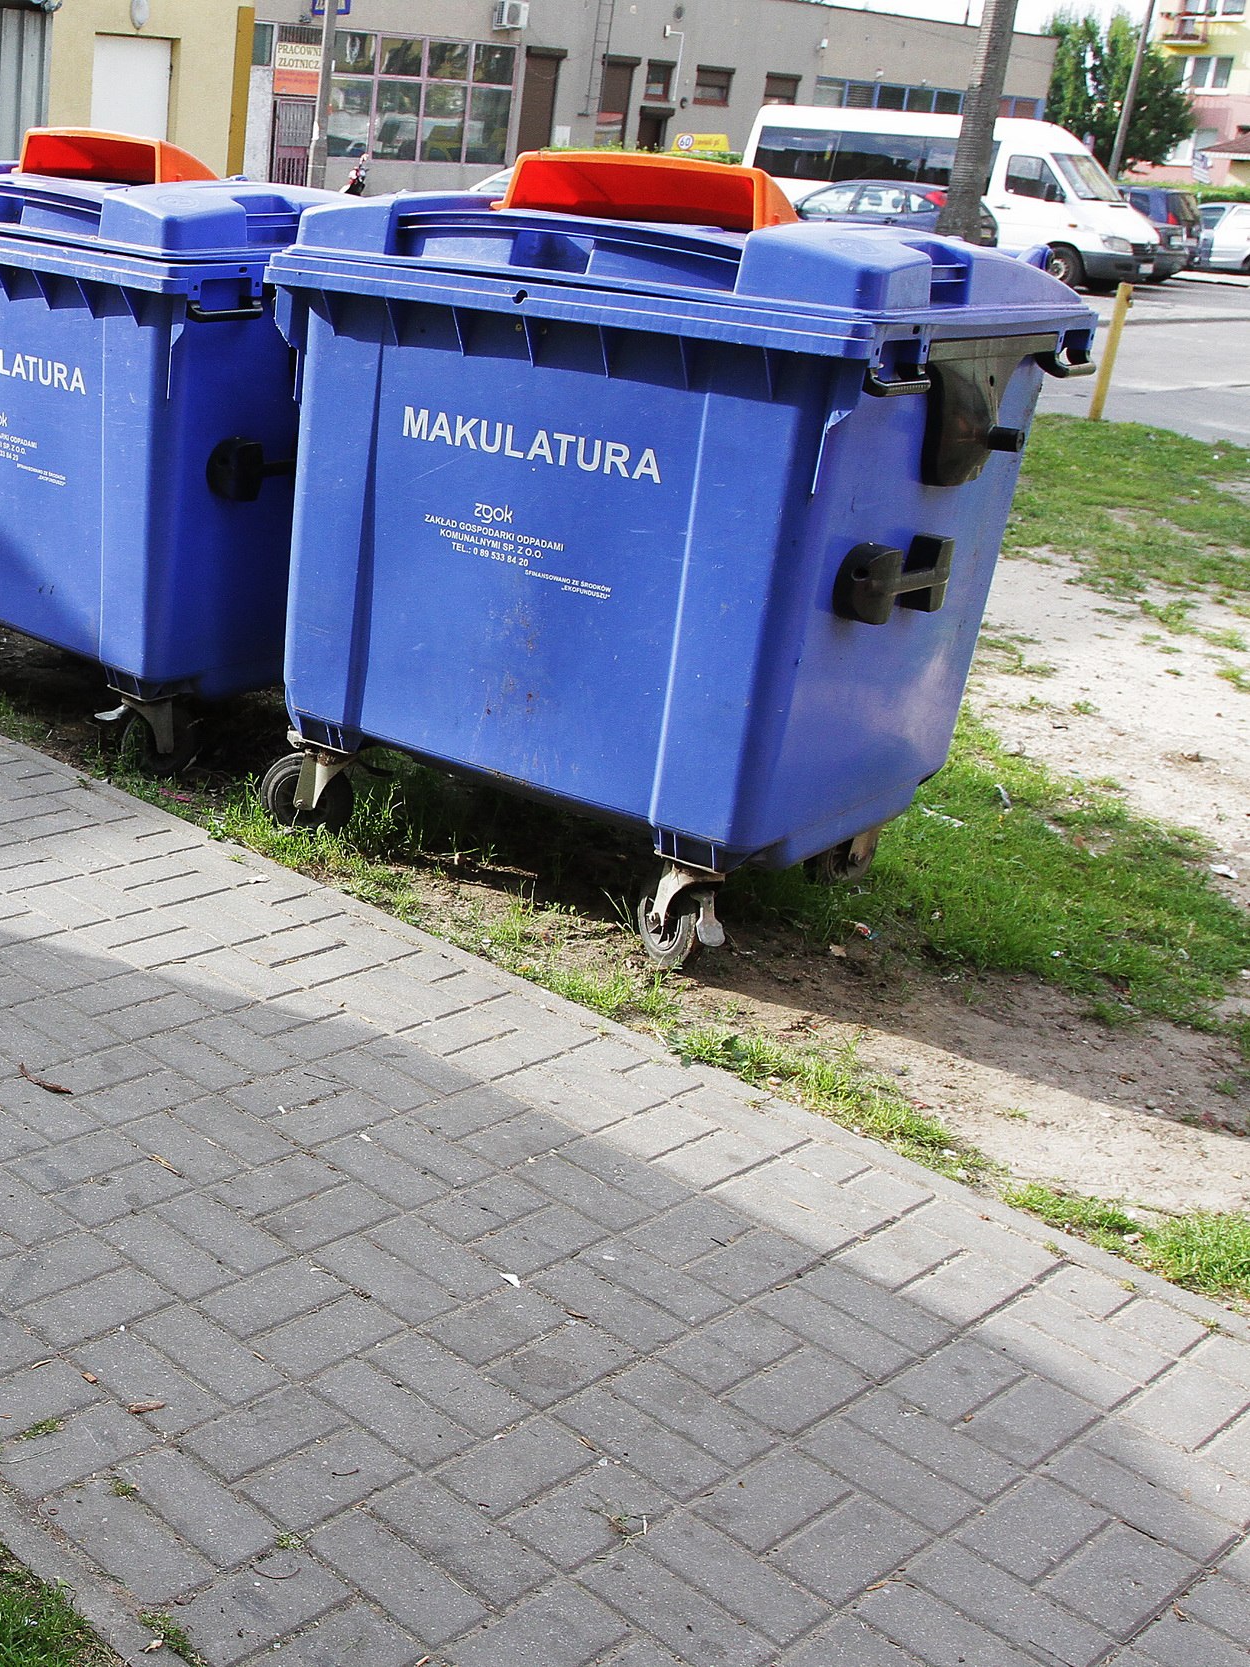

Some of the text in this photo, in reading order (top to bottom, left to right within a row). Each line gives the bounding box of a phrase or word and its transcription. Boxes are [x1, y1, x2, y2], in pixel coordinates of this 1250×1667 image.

[278, 58, 320, 70] ZŁOTNICZ
[402, 406, 662, 484] MAKULATURA
[474, 502, 513, 524] zgok
[424, 514, 564, 552] ZAKŁAD GOSPODARKI ODPADAMI
[440, 528, 501, 549] KOMUNALNYMI
[502, 542, 515, 553] SP.
[517, 546, 523, 554] Z
[452, 542, 529, 567] TEL.: 0 89 533 84 20
